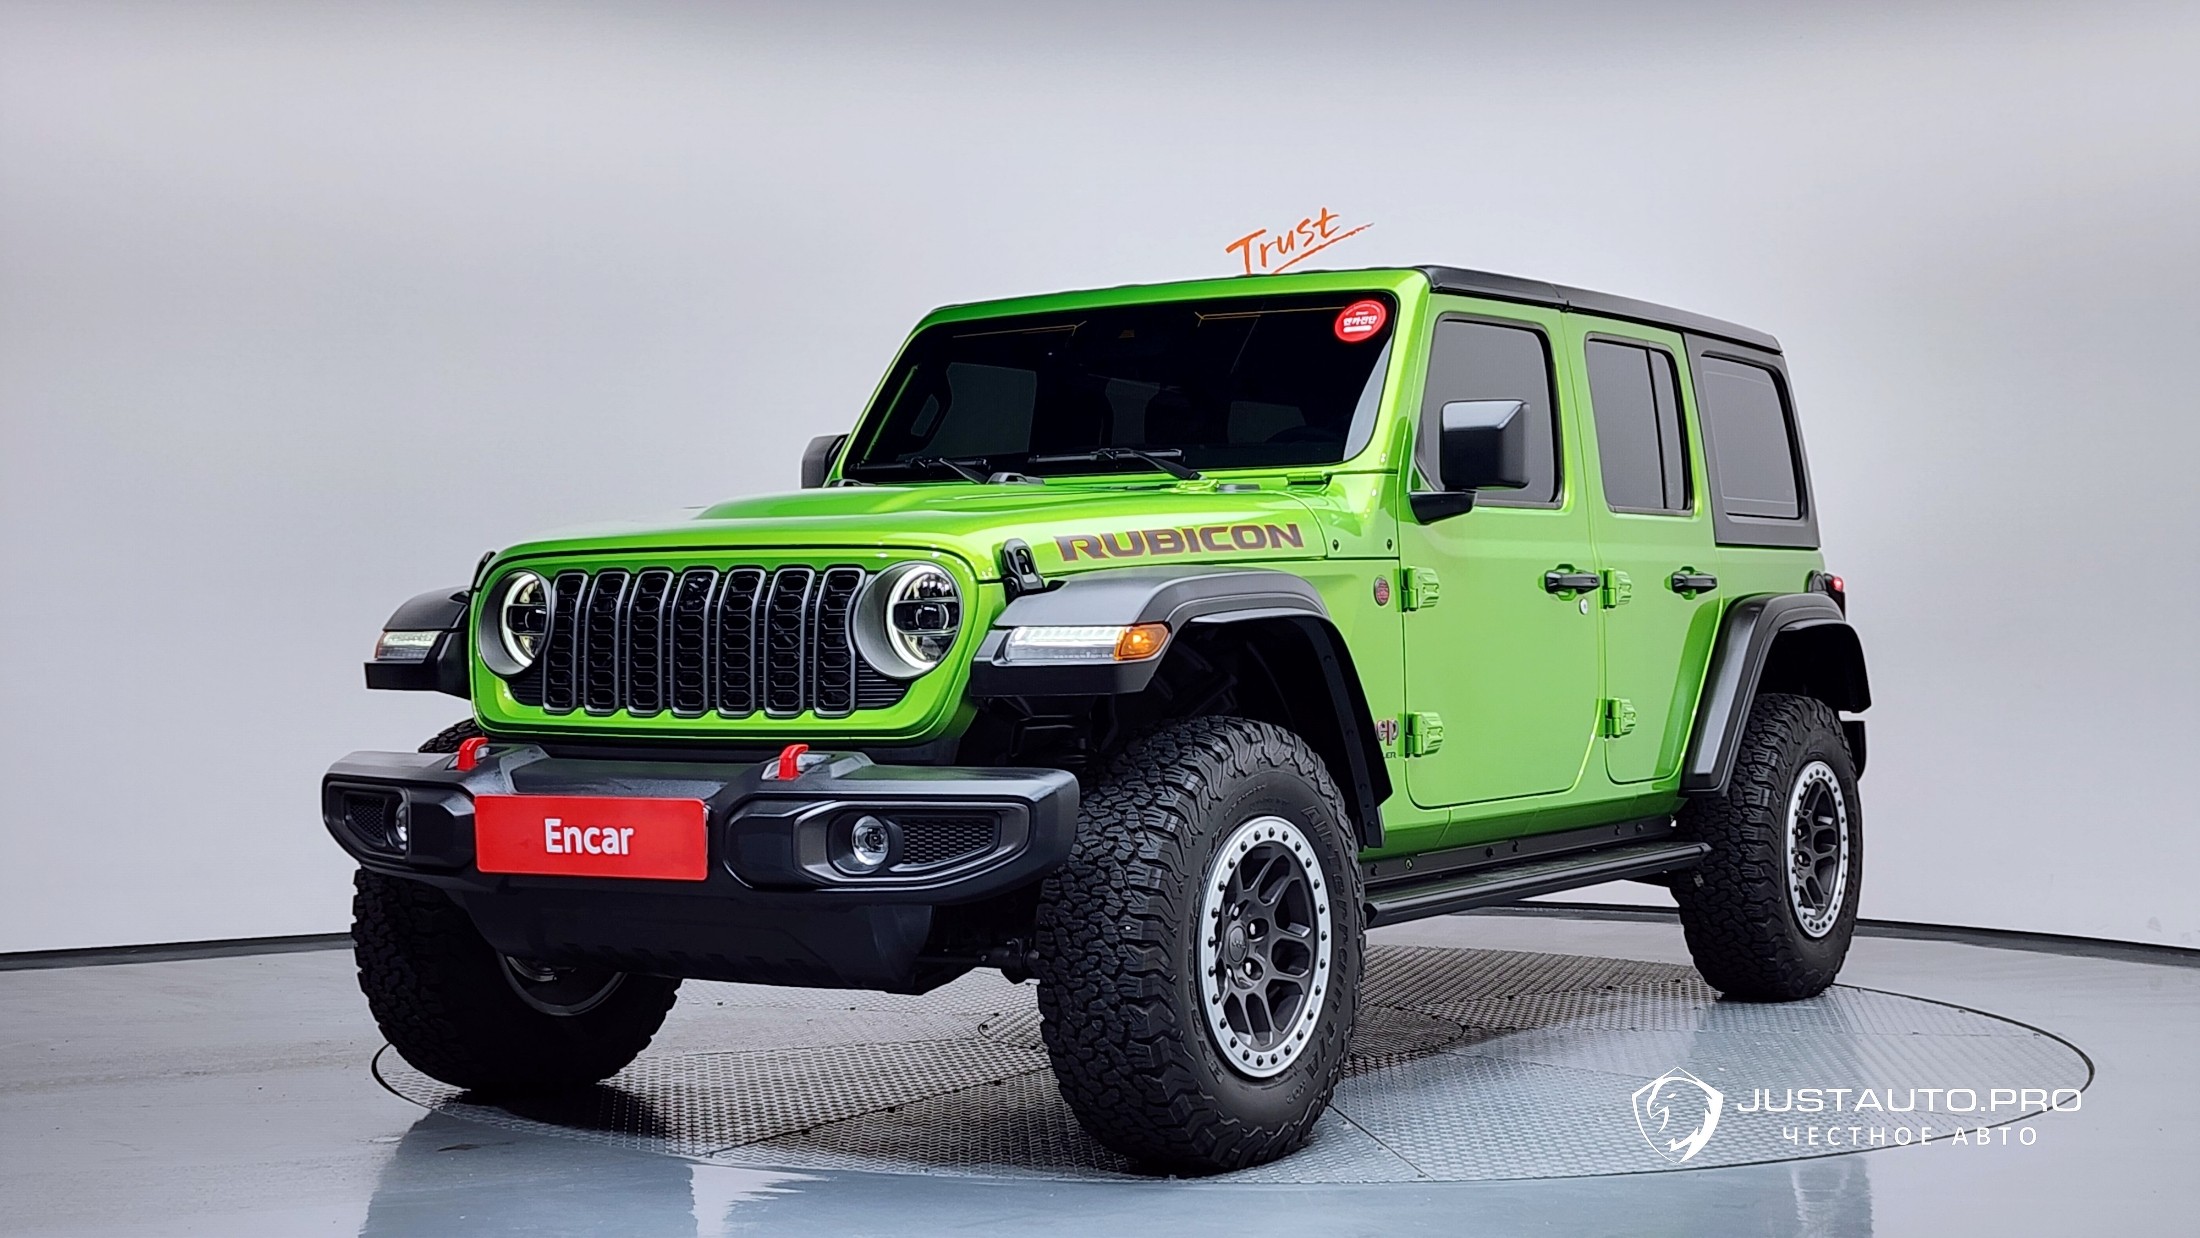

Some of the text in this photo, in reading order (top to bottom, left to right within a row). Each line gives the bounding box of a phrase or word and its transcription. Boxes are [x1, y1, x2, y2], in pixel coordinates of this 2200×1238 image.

[1225, 206, 1341, 276] Trust
[1053, 523, 1305, 562] RUBICON
[544, 817, 635, 855] Encar
